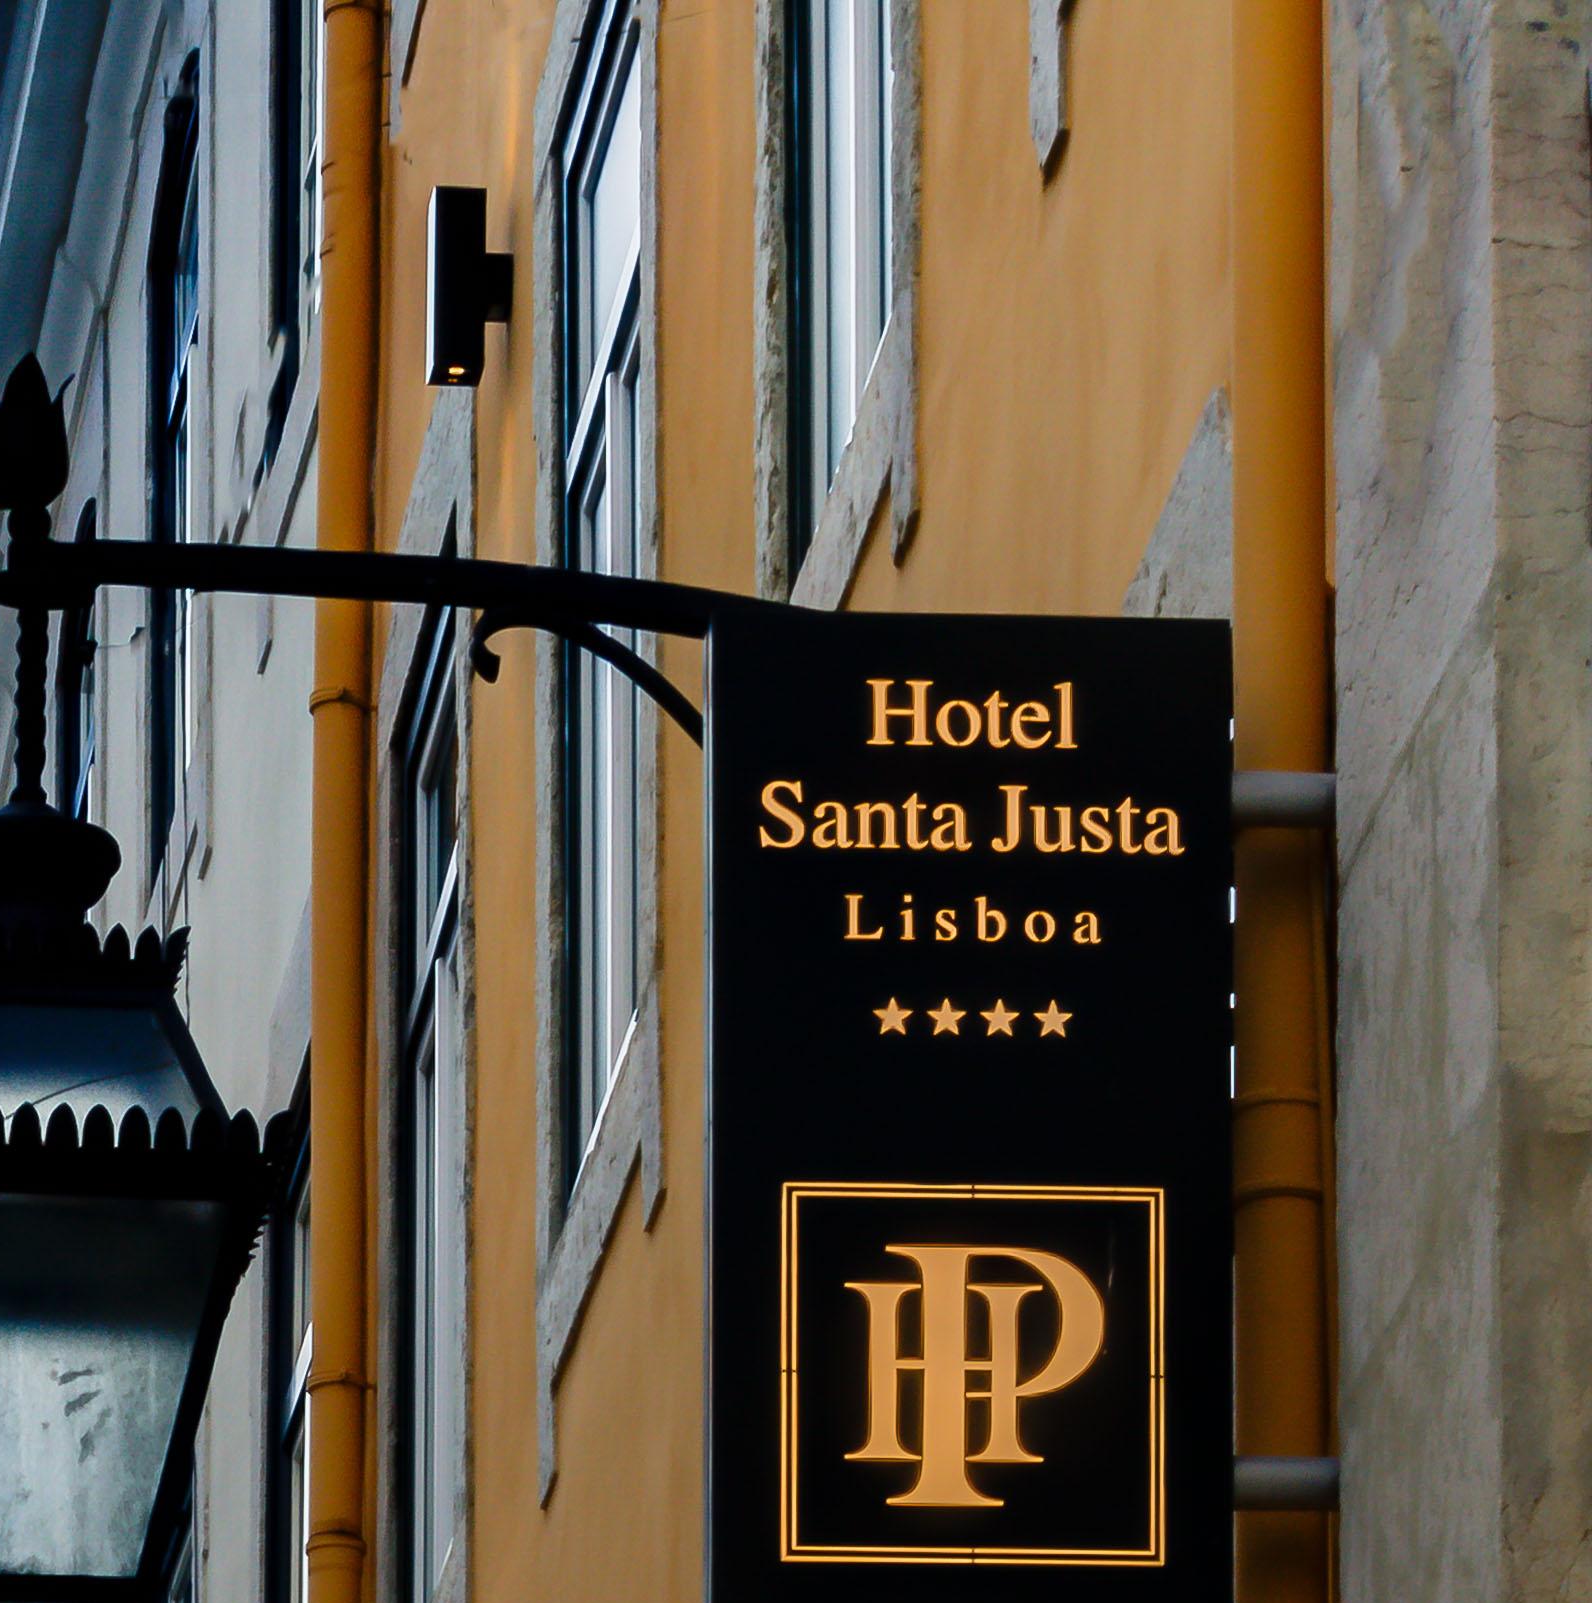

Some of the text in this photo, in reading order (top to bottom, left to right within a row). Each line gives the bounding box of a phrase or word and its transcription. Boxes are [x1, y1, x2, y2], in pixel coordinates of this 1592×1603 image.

[866, 678, 1078, 749] Hotel
[759, 780, 1185, 856] Santa Justa
[844, 894, 1101, 944] Lisboa
